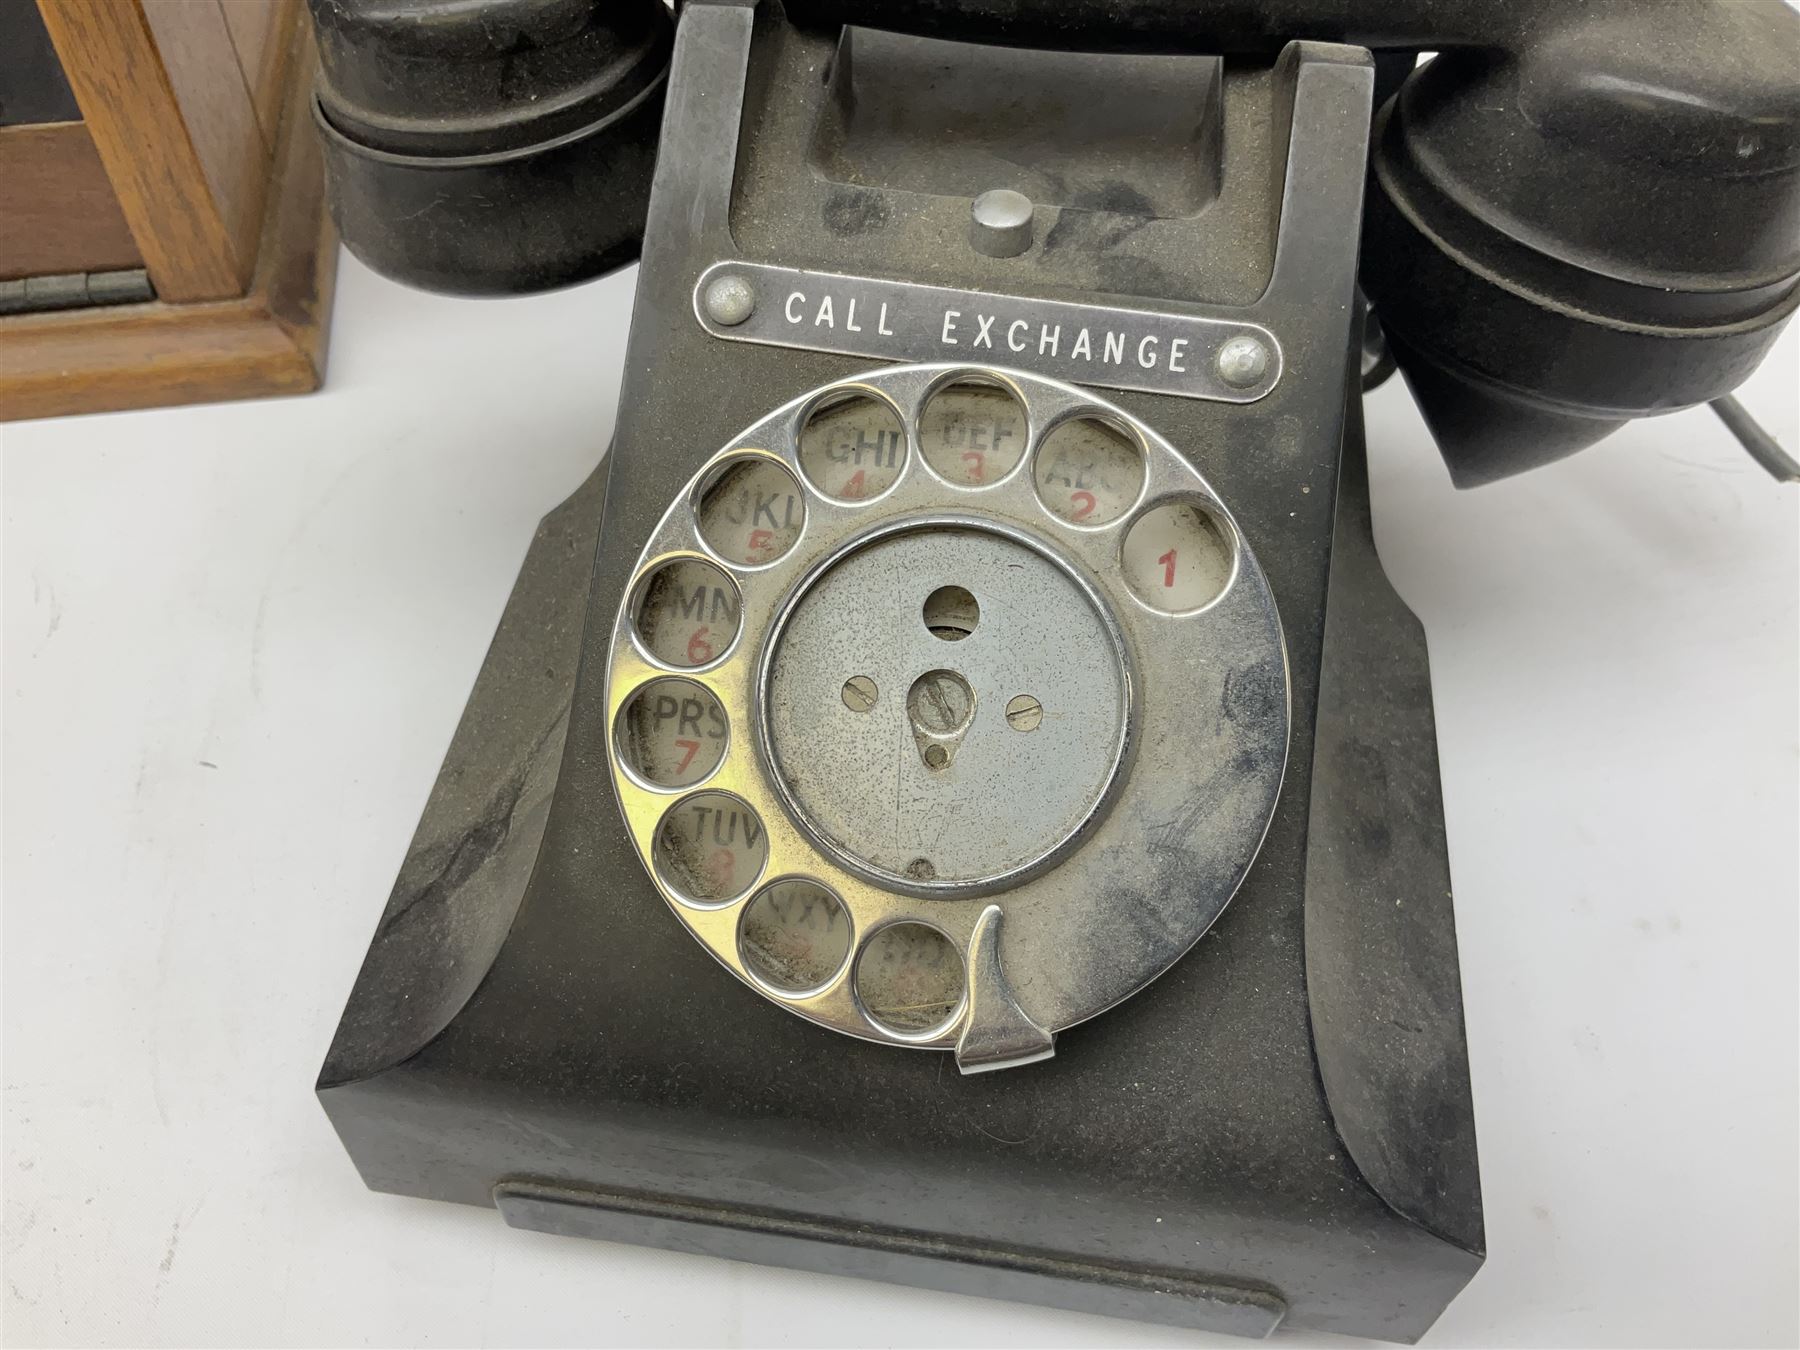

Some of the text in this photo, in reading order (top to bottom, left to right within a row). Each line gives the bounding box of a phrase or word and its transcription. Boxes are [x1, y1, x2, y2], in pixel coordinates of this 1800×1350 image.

[785, 291, 1189, 372] CALL EXCHANGE
[824, 425, 899, 468] GHI
[1070, 490, 1097, 522] 2
[1158, 549, 1177, 587] 1
[687, 626, 713, 664] 6
[653, 695, 725, 739] PRS
[675, 739, 700, 775] 7
[692, 806, 762, 849] TUV
